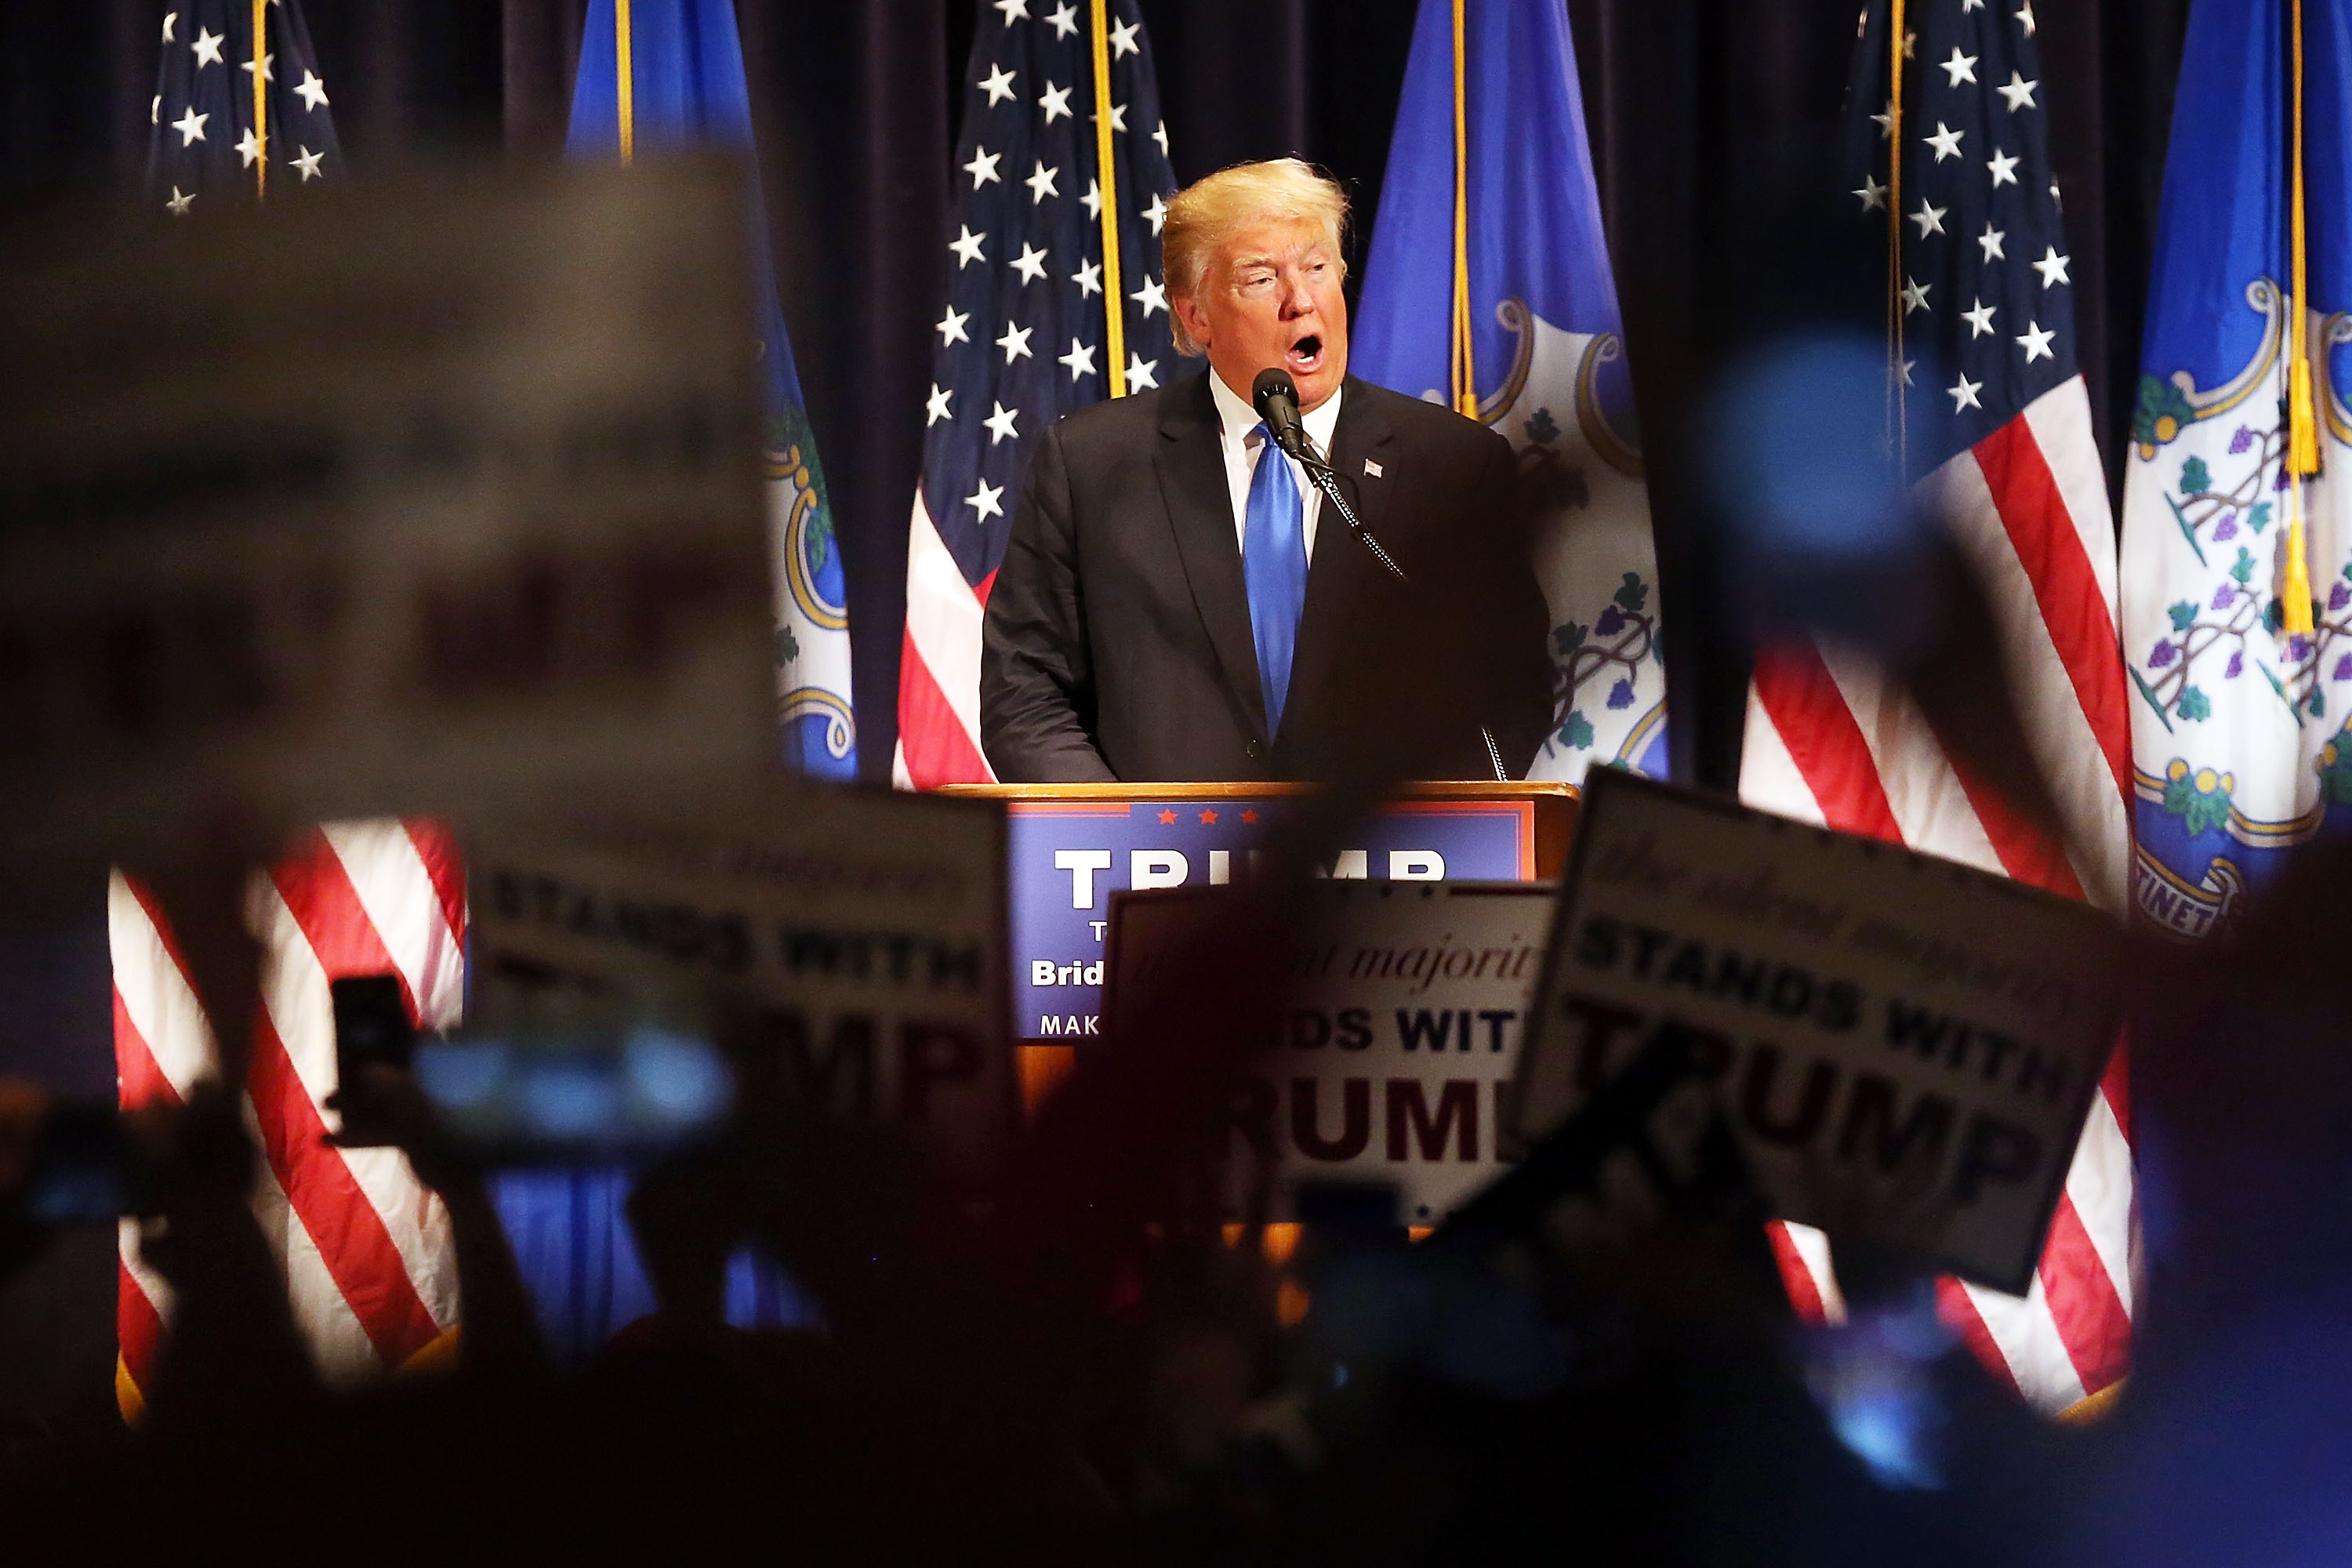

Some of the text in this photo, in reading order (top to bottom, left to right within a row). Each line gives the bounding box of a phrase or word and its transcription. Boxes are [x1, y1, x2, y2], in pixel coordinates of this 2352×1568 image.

[1031, 959, 1105, 986] Brid
[1348, 933, 1541, 995] majorit
[1040, 1014, 1100, 1035] MAK
[1396, 1008, 1515, 1052] WIT
[1574, 911, 2076, 1102] STANDS WITH
[1214, 1076, 1525, 1163] RUM
